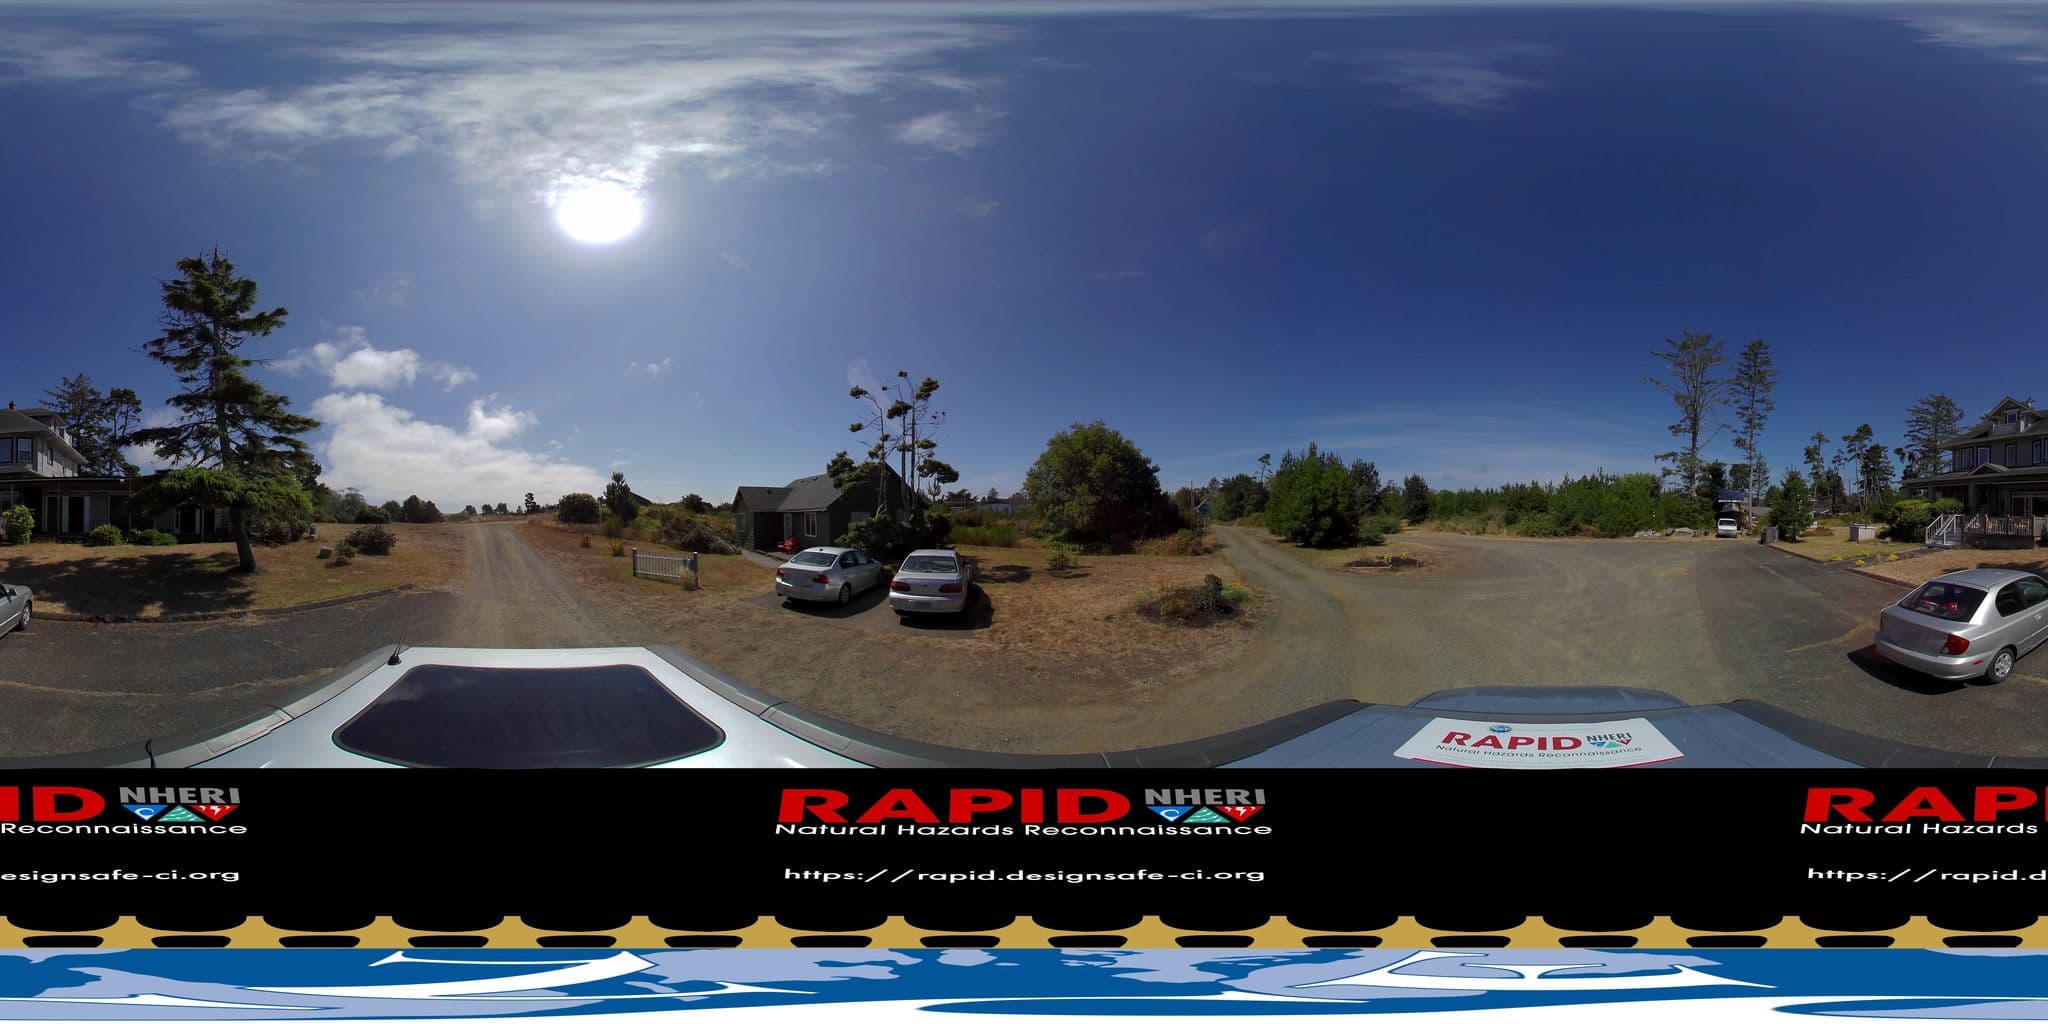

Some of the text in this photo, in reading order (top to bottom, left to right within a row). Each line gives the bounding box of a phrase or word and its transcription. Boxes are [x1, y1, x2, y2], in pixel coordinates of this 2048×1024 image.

[1441, 731, 1632, 750] RAPID NHERI
[1435, 744, 1480, 755] Natural
[1538, 746, 1642, 758] Reconnaissance
